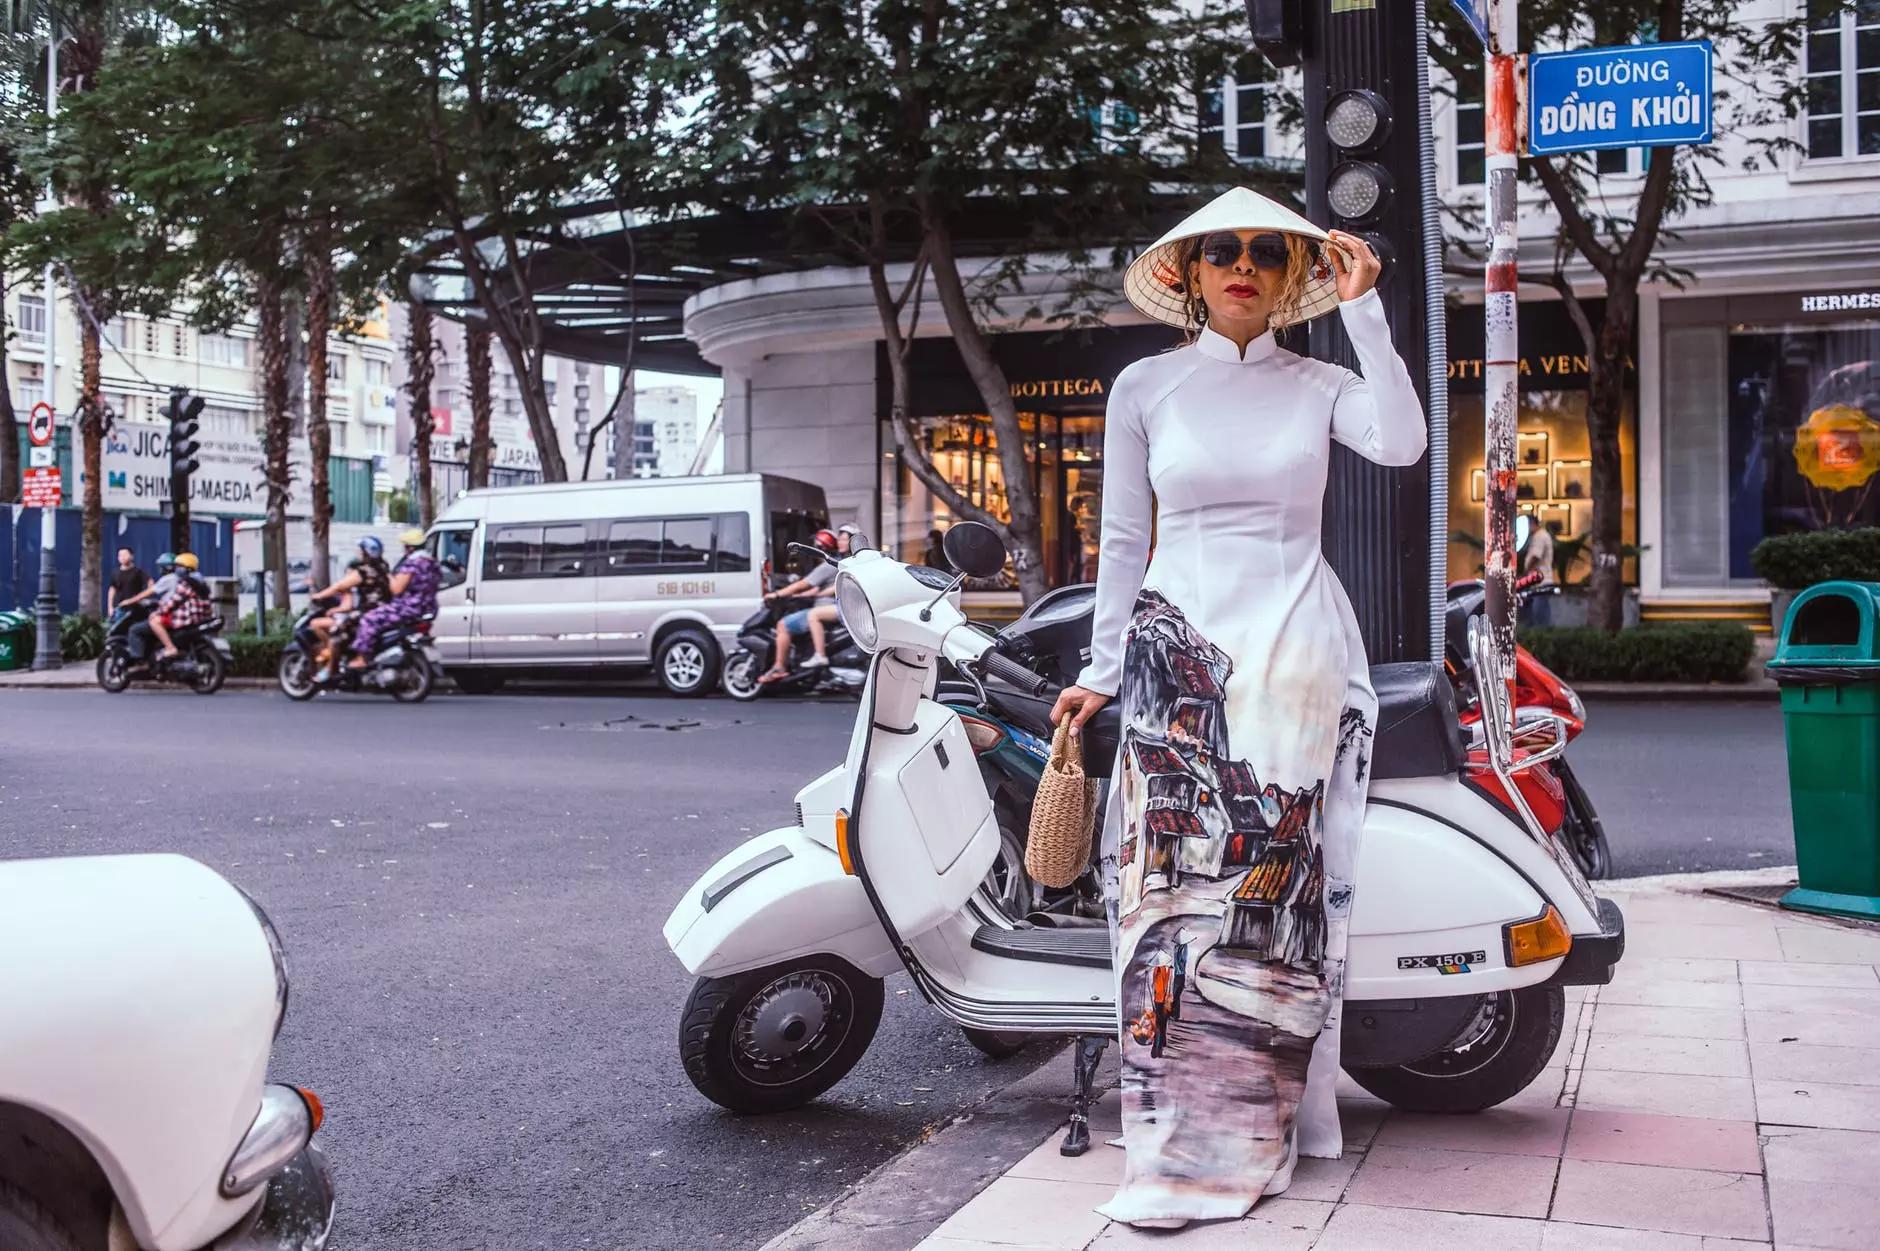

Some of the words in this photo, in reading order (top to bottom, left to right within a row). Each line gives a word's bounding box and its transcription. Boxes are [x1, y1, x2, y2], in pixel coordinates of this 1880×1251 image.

[1576, 58, 1669, 87] ĐƯỜNG
[1540, 91, 1616, 135] ĐỒNG
[1632, 82, 1700, 127] KHỞI
[1011, 378, 1104, 397] BOTTEGA
[134, 475, 252, 501] SHIMU-MAEDA
[1400, 957, 1428, 968] PX
[1436, 954, 1466, 966] 150
[1472, 952, 1485, 963] E
